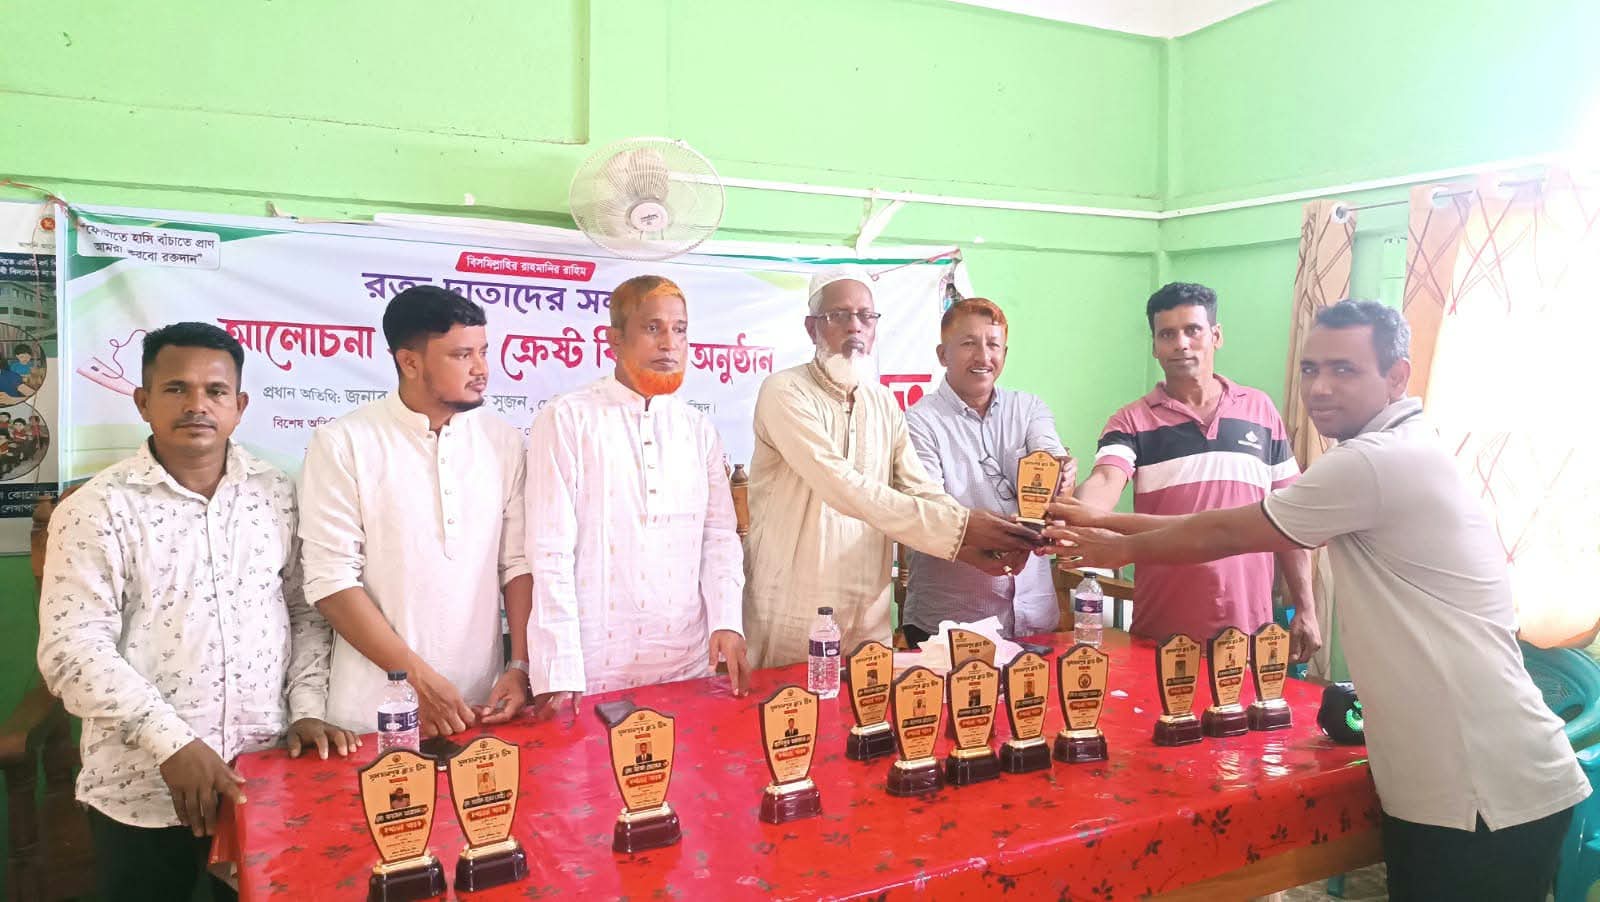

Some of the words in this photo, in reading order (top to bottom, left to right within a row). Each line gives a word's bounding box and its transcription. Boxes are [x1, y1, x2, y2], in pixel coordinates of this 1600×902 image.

[131, 232, 154, 245] হাসি
[157, 233, 192, 247] বাঁচাতে
[195, 239, 215, 250] প্রাণ
[562, 264, 587, 277] রাহিম
[216, 318, 376, 371] আলোচনা
[501, 327, 585, 381] ক্রেষ্ট
[689, 333, 774, 385] অনুষ্ঠান
[263, 386, 296, 400] প্রধান
[273, 416, 304, 429] বিশেষ
